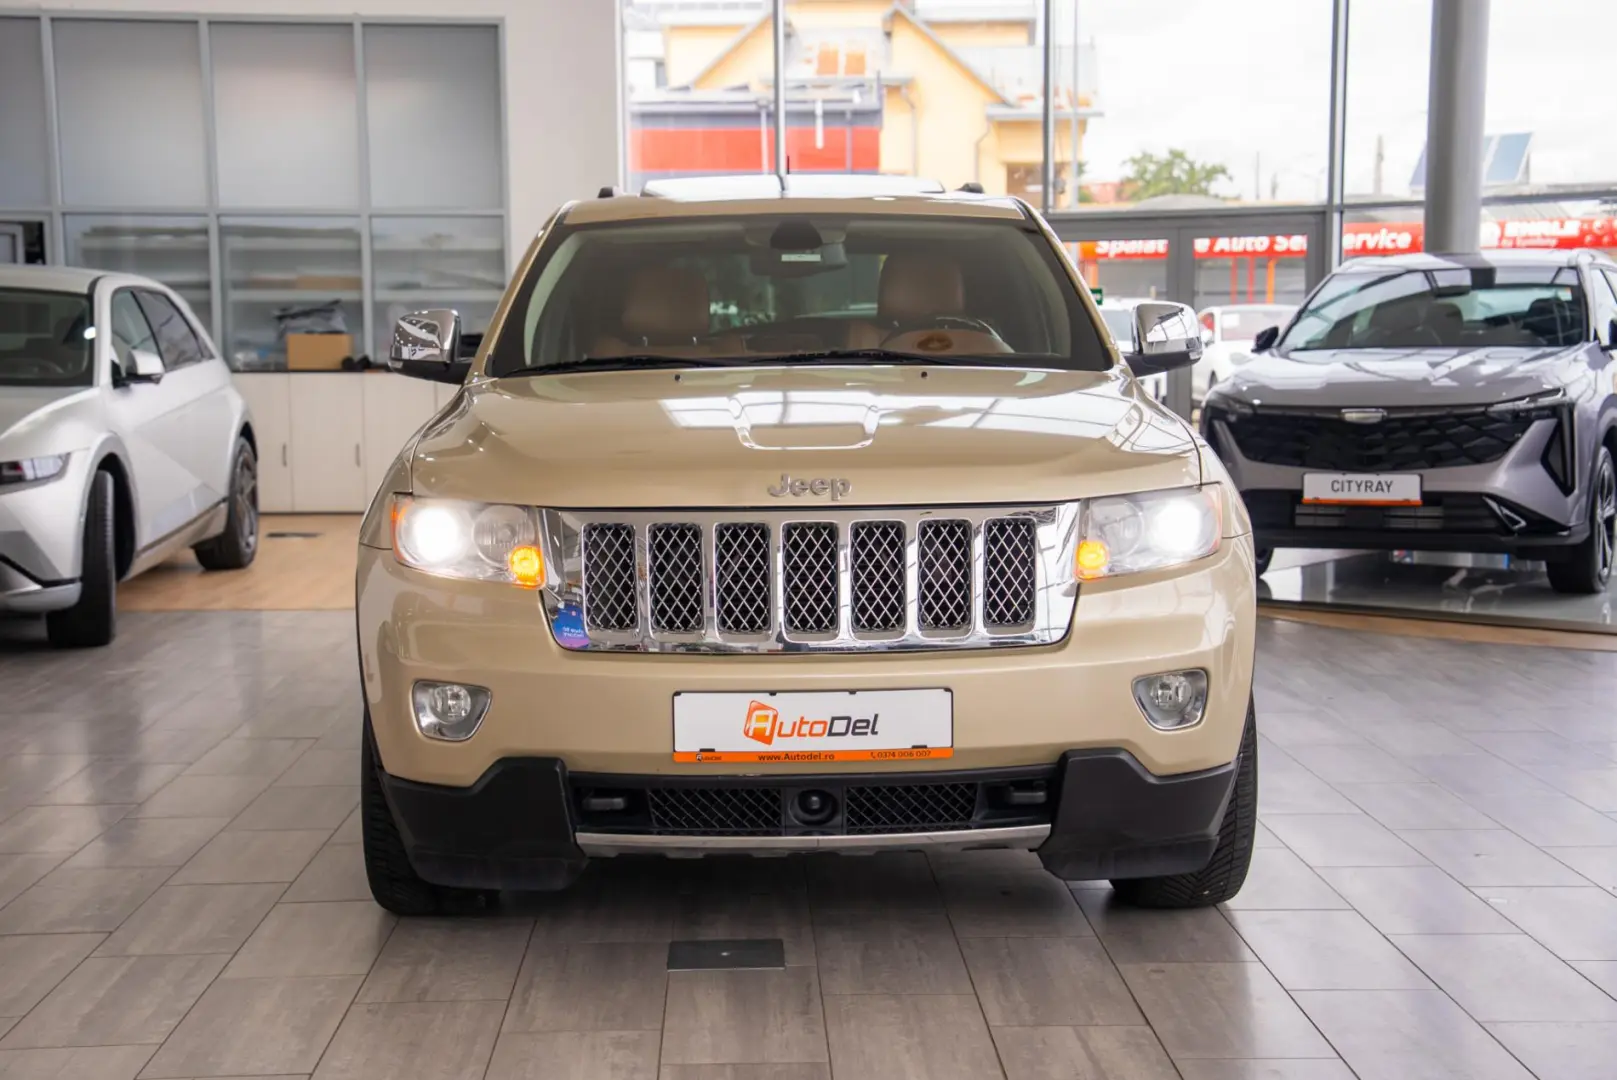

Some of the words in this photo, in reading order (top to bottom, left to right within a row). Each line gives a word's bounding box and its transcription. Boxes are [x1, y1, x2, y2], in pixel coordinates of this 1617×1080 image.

[1342, 228, 1412, 250] ervice
[767, 473, 852, 501] Jeep
[1331, 480, 1394, 494] CITYRAY
[747, 706, 879, 739] AutoDel
